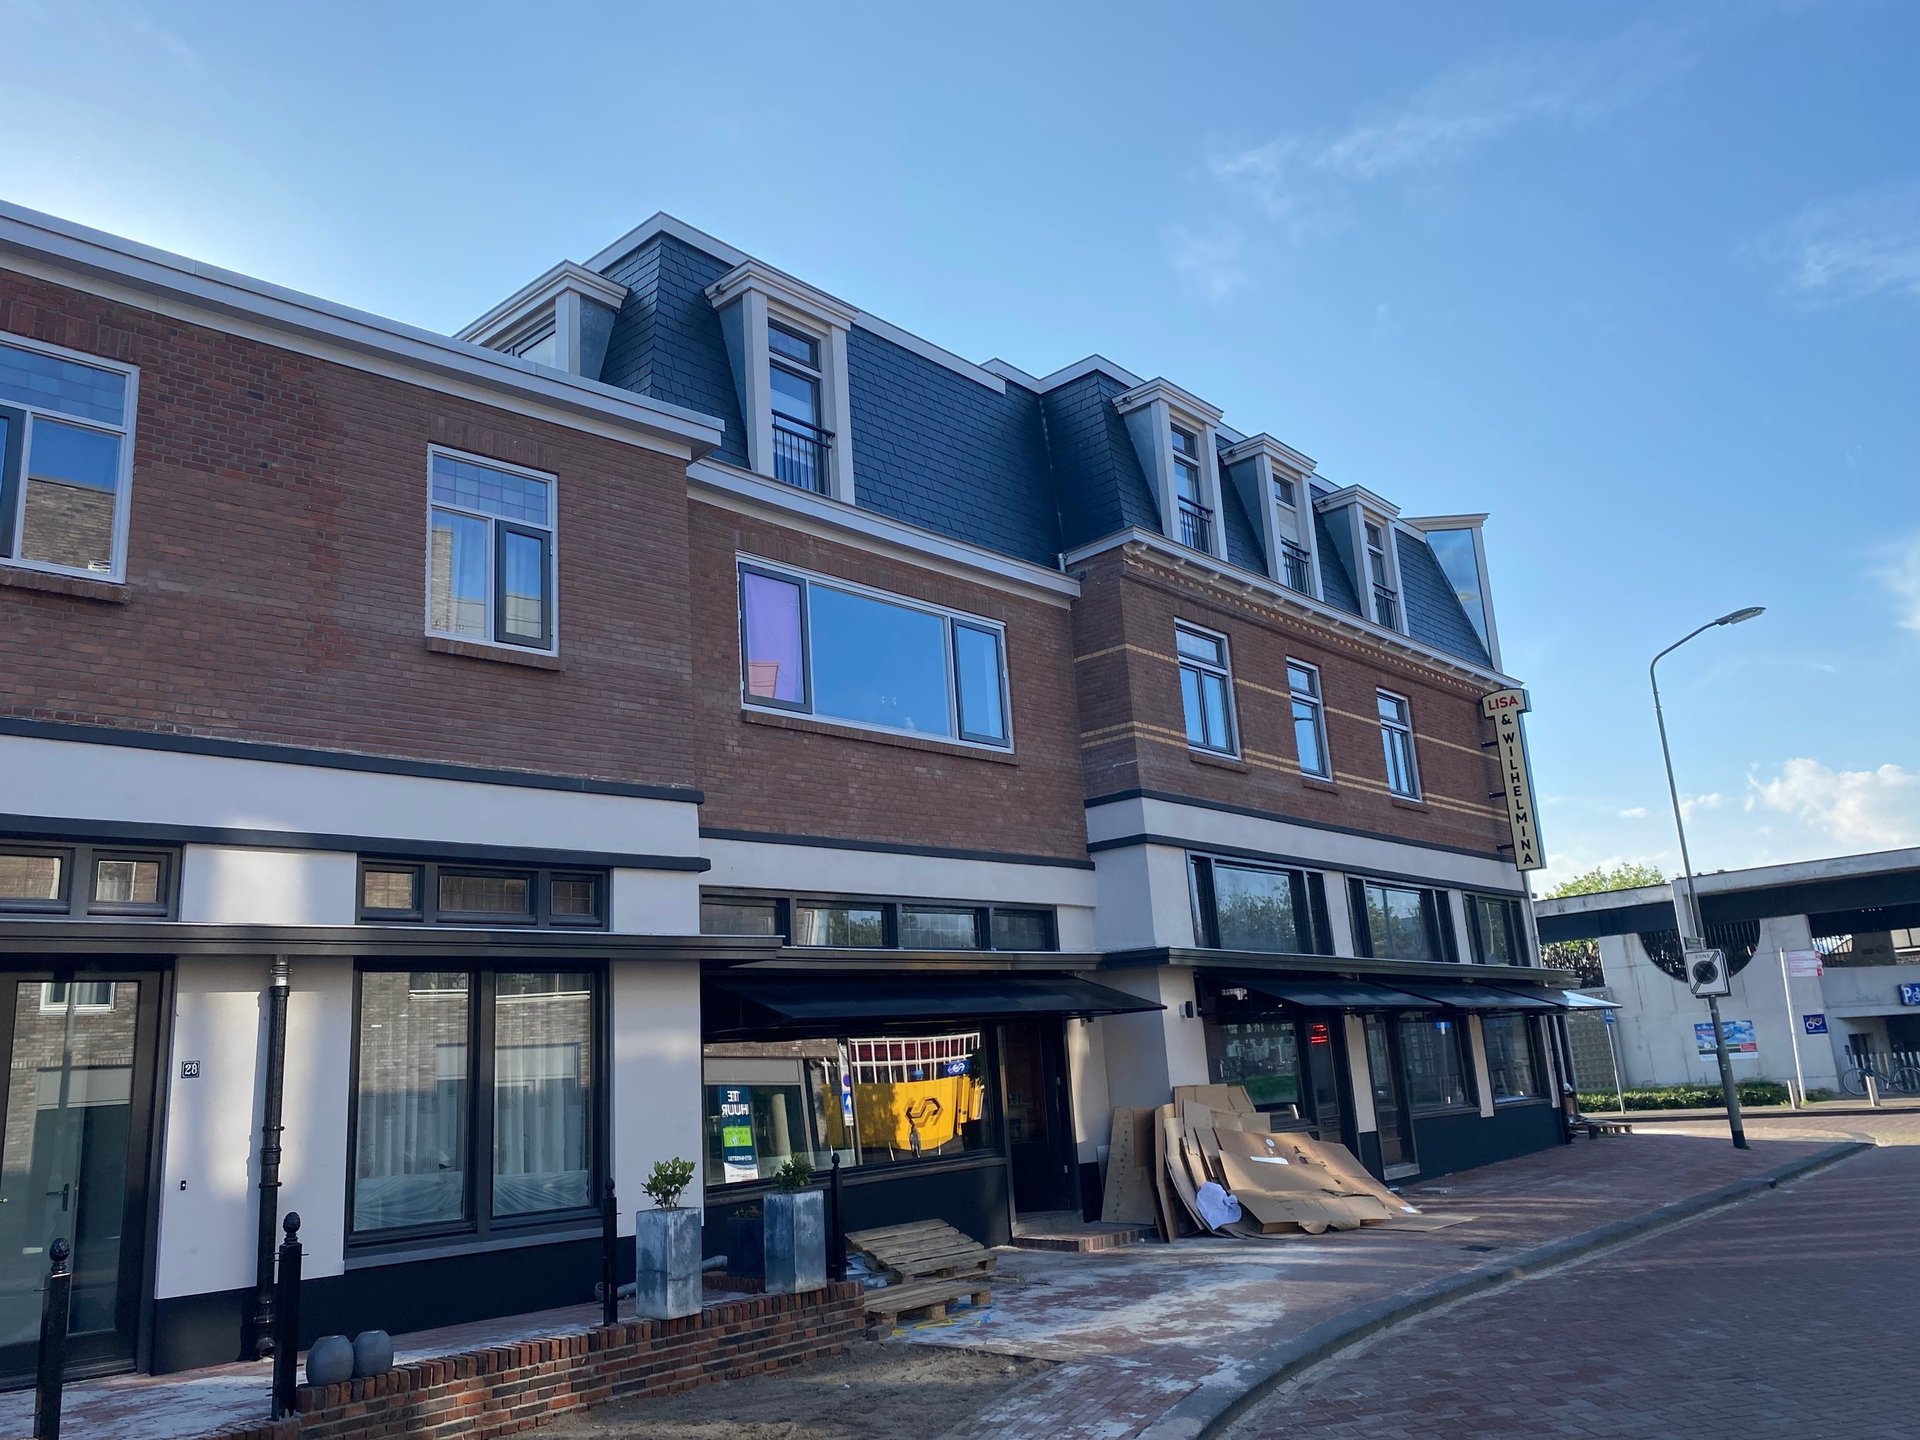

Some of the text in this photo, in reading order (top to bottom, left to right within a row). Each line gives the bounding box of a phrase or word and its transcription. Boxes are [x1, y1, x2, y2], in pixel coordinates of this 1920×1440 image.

[1488, 695, 1518, 711] LISA
[1501, 714, 1534, 865] & WILHELMINA
[1903, 987, 1912, 1003] P
[185, 1063, 197, 1075] 28
